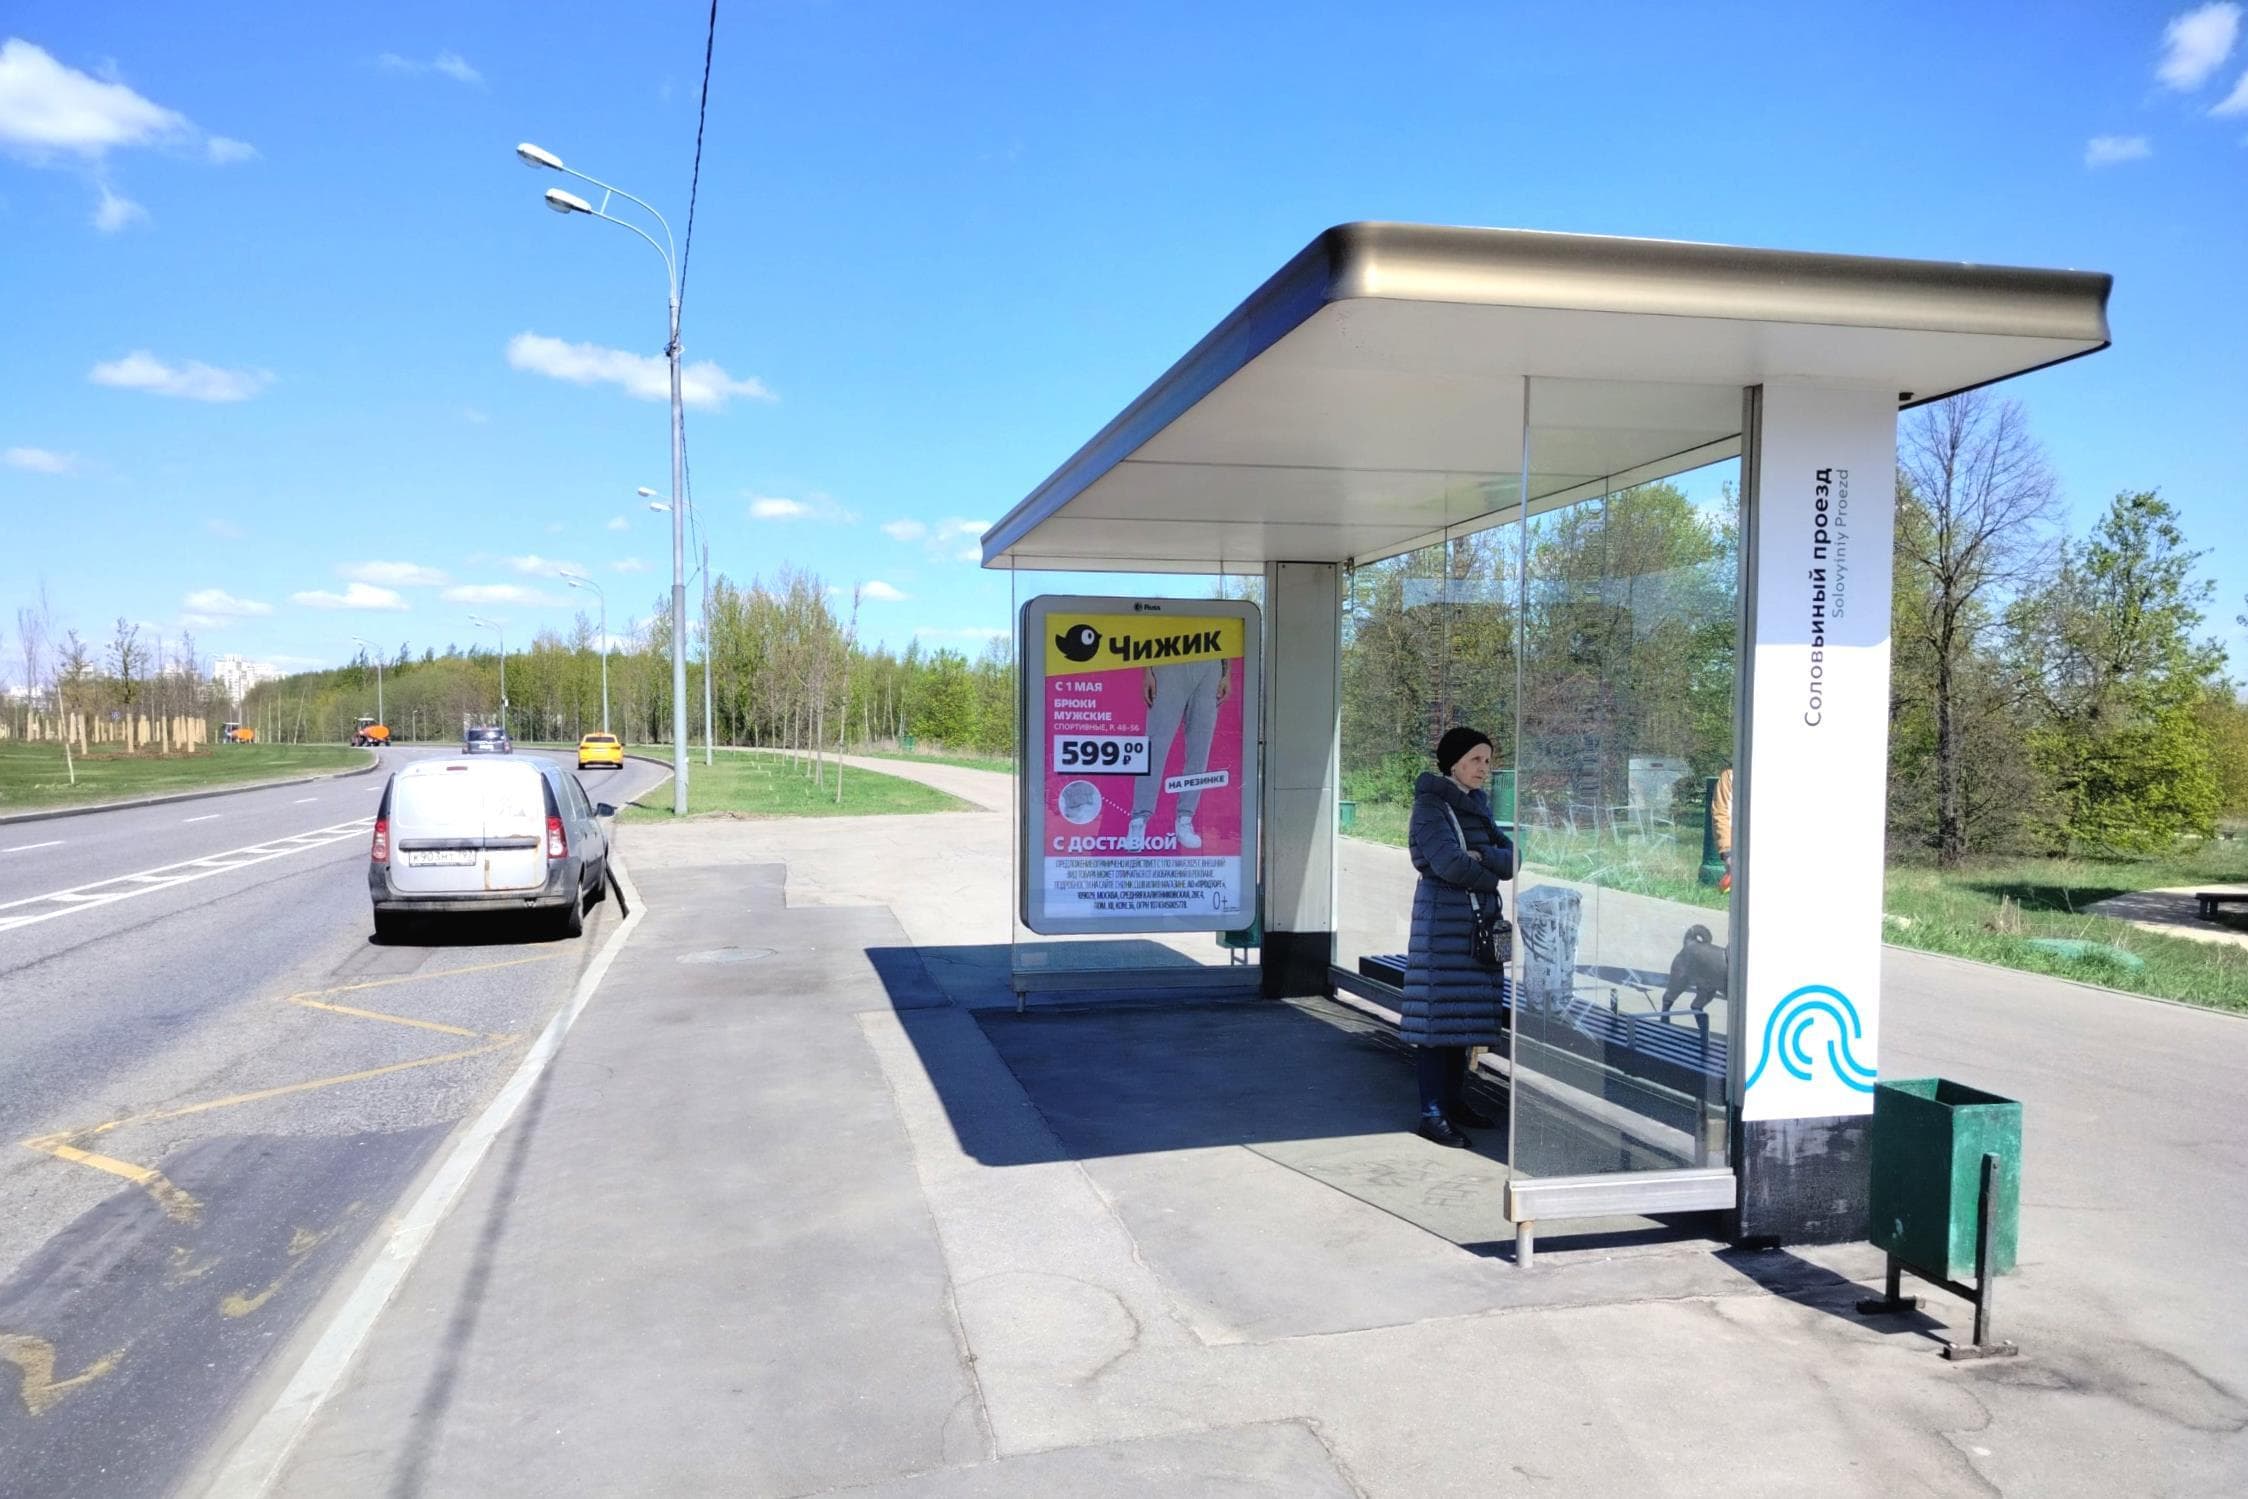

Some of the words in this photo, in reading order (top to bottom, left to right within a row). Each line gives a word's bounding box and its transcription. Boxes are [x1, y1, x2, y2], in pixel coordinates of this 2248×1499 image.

[1836, 469, 1849, 527] Proezd
[1811, 468, 1833, 560] проезд
[1832, 531, 1849, 618] Solovyiniy
[1804, 571, 1827, 727] Соловьиный
[1055, 682, 1064, 692] С
[1066, 682, 1072, 692] 1
[1074, 682, 1103, 692] МАЯ
[1054, 699, 1097, 709] БРЮКИ
[1054, 711, 1112, 721] МУЖСКИЕ
[1061, 741, 1120, 765] 599
[1124, 743, 1144, 754] 00
[1168, 780, 1183, 790] НА
[1184, 775, 1226, 788] РЕЗИНКЕ
[1053, 836, 1064, 850] С
[1068, 832, 1177, 852] ДОСТАВКОЙ
[1212, 891, 1228, 910] 0+
